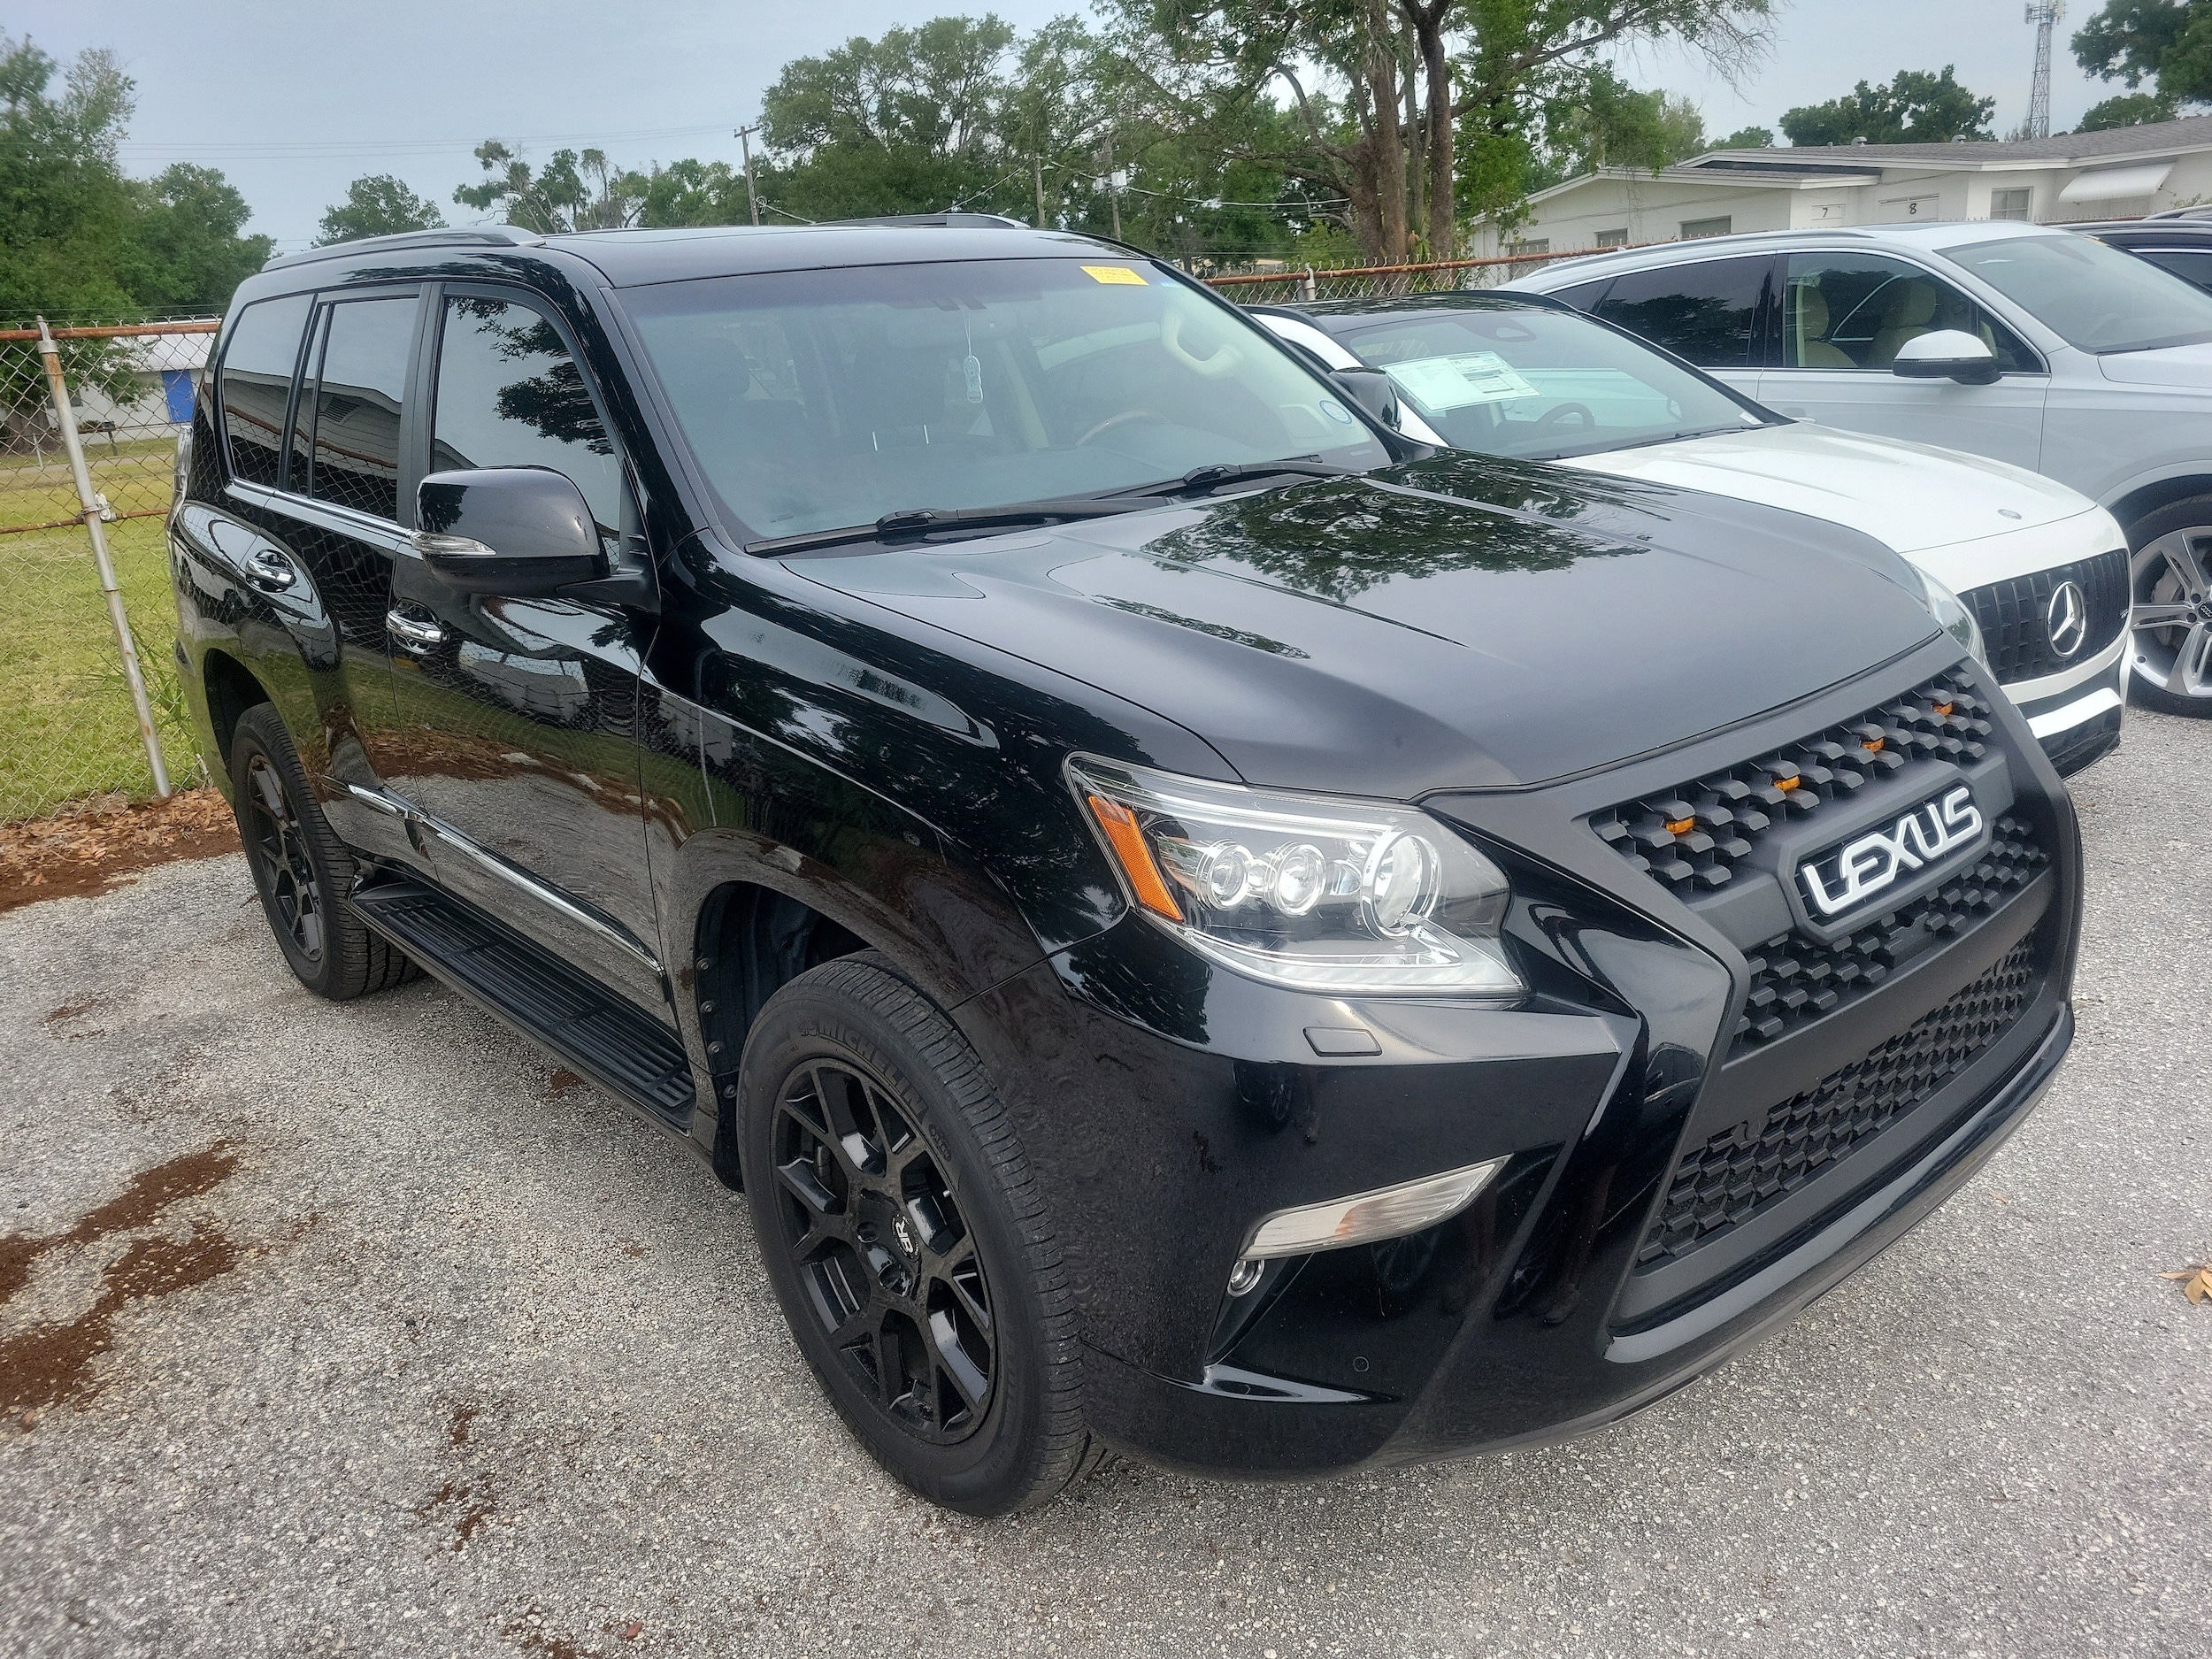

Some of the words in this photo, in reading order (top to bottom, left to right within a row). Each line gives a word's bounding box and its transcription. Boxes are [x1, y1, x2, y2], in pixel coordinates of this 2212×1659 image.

[1822, 207, 1828, 218] 7
[1909, 203, 1917, 214] 8
[1801, 786, 1983, 915] LEXUS
